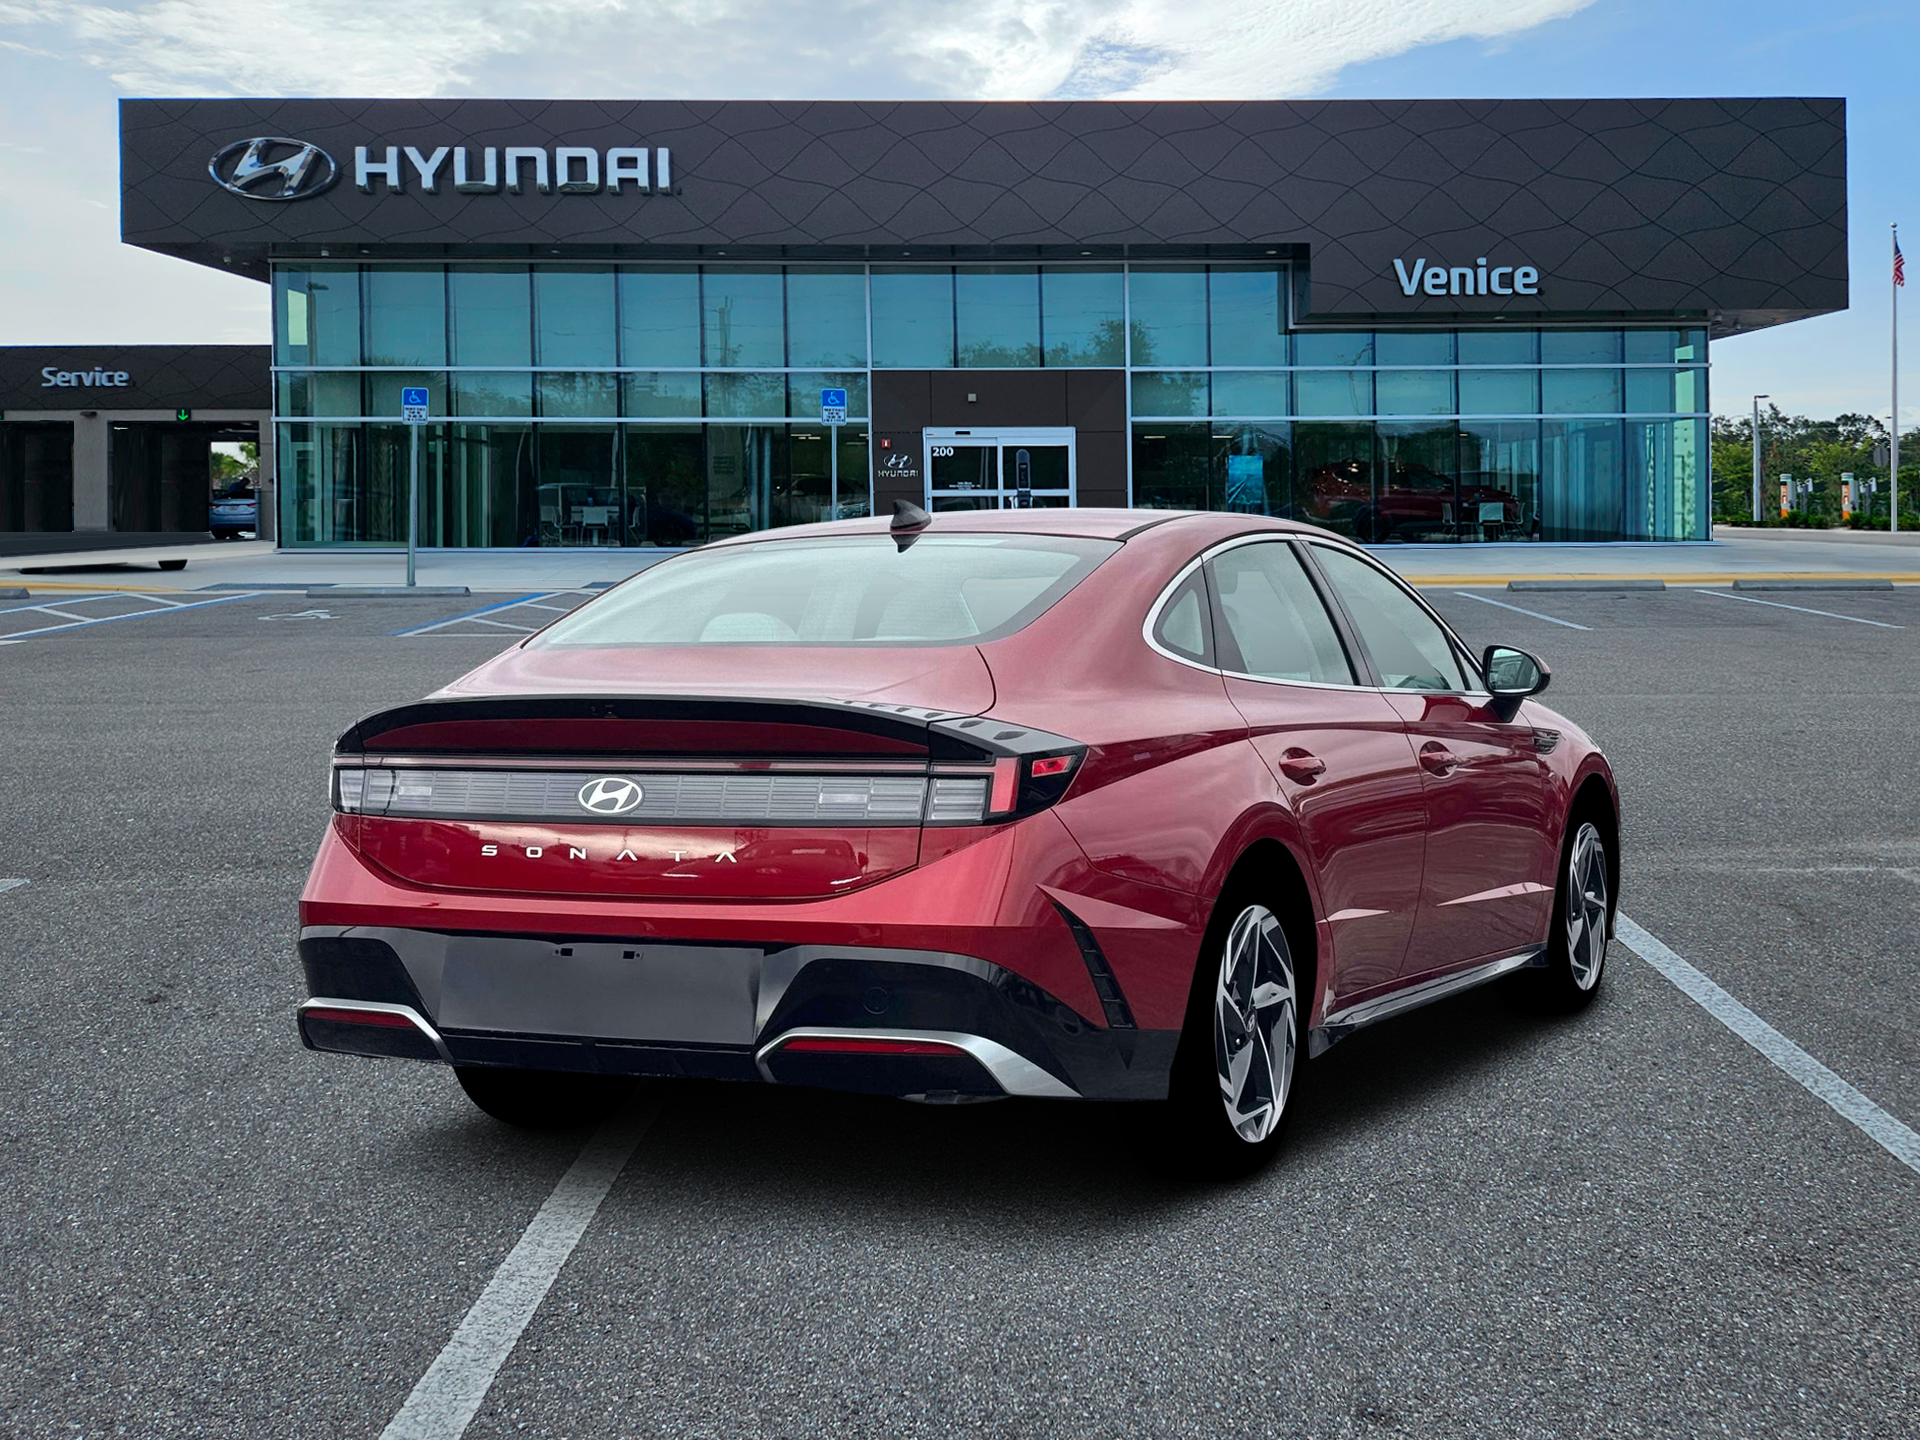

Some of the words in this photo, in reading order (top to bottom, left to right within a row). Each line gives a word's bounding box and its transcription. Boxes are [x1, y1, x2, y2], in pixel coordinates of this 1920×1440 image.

[354, 146, 672, 195] HYUNDAI
[1393, 257, 1539, 296] Venice
[41, 366, 130, 387] Service
[932, 446, 954, 457] 200
[877, 470, 919, 478] HYUNDAI
[481, 844, 738, 863] SONATA
